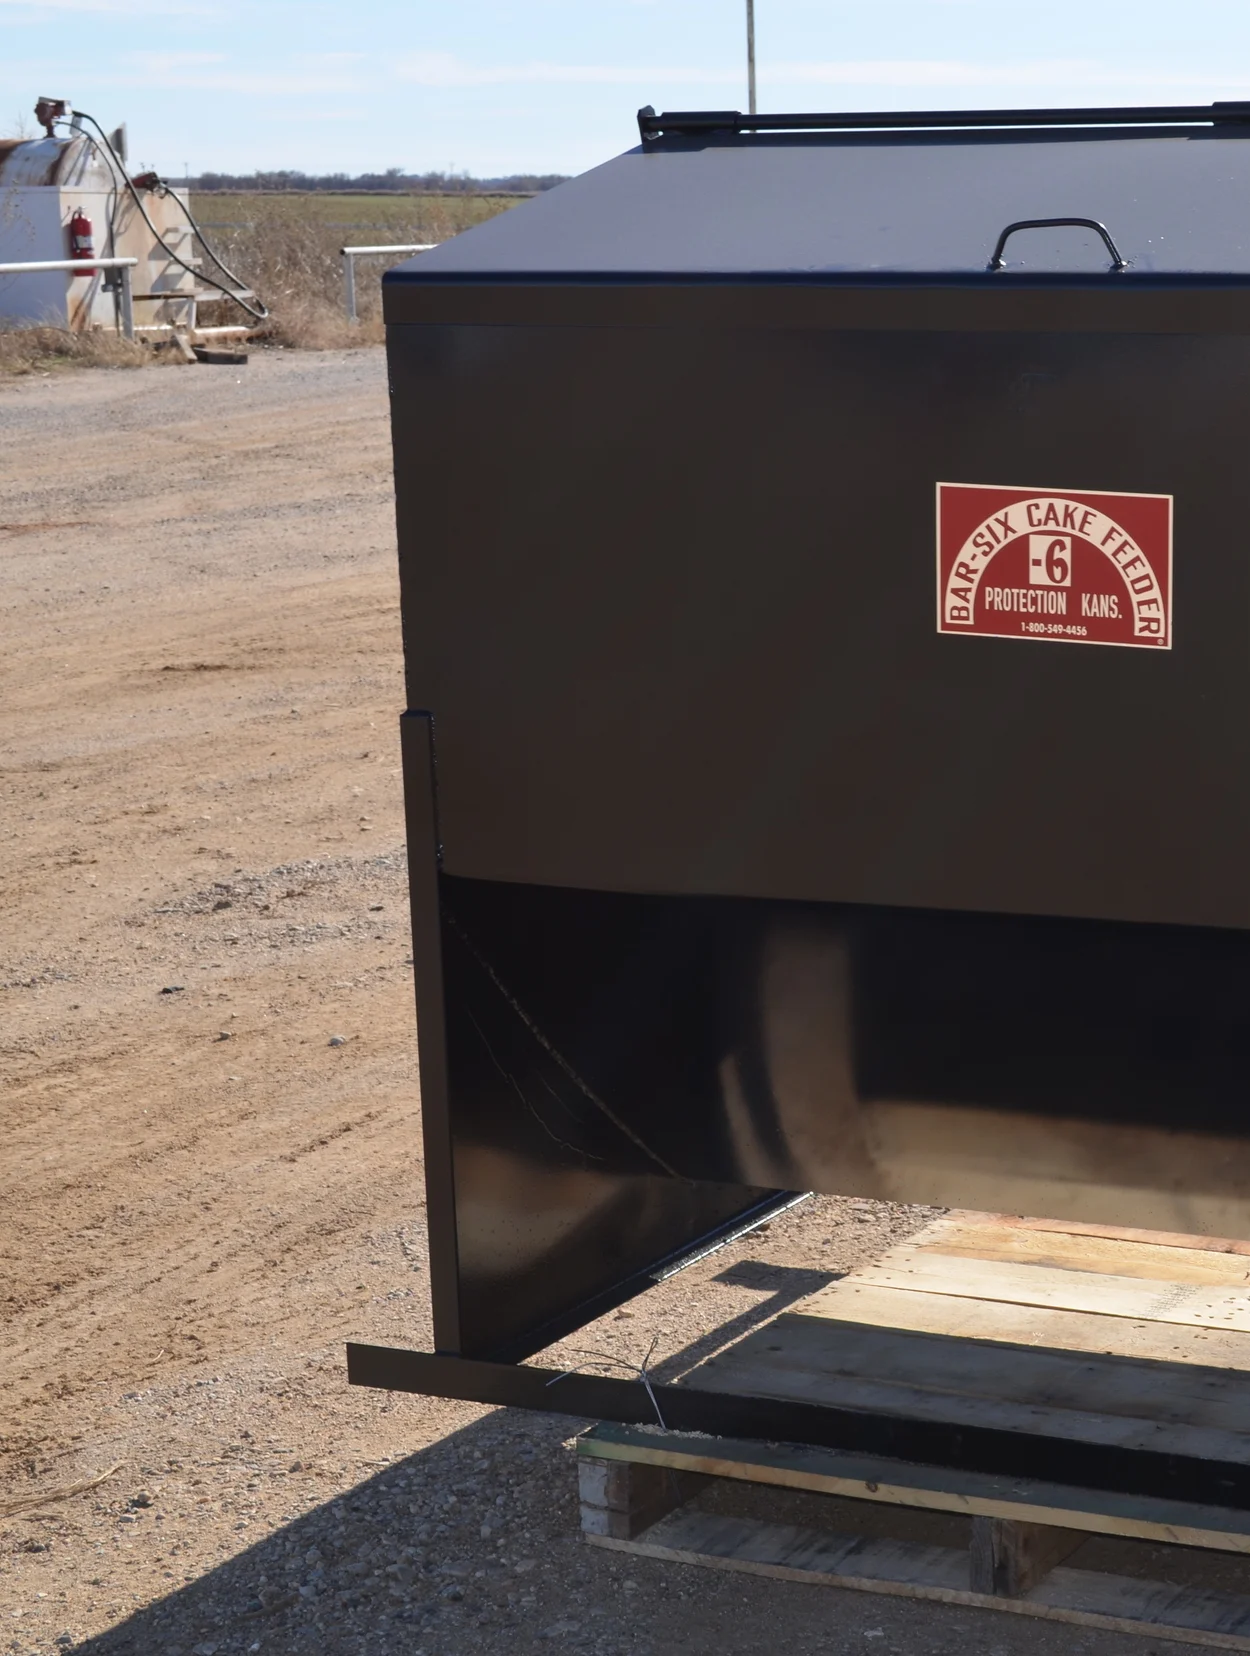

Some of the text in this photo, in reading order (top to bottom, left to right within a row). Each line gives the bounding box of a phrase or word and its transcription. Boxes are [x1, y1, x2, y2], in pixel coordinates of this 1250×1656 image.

[950, 502, 1162, 636] BAR-SIX CAKE FEEDER
[985, 587, 1123, 619] PROTECTION KANS.
[1021, 622, 1088, 636] 1-800-549-4456
